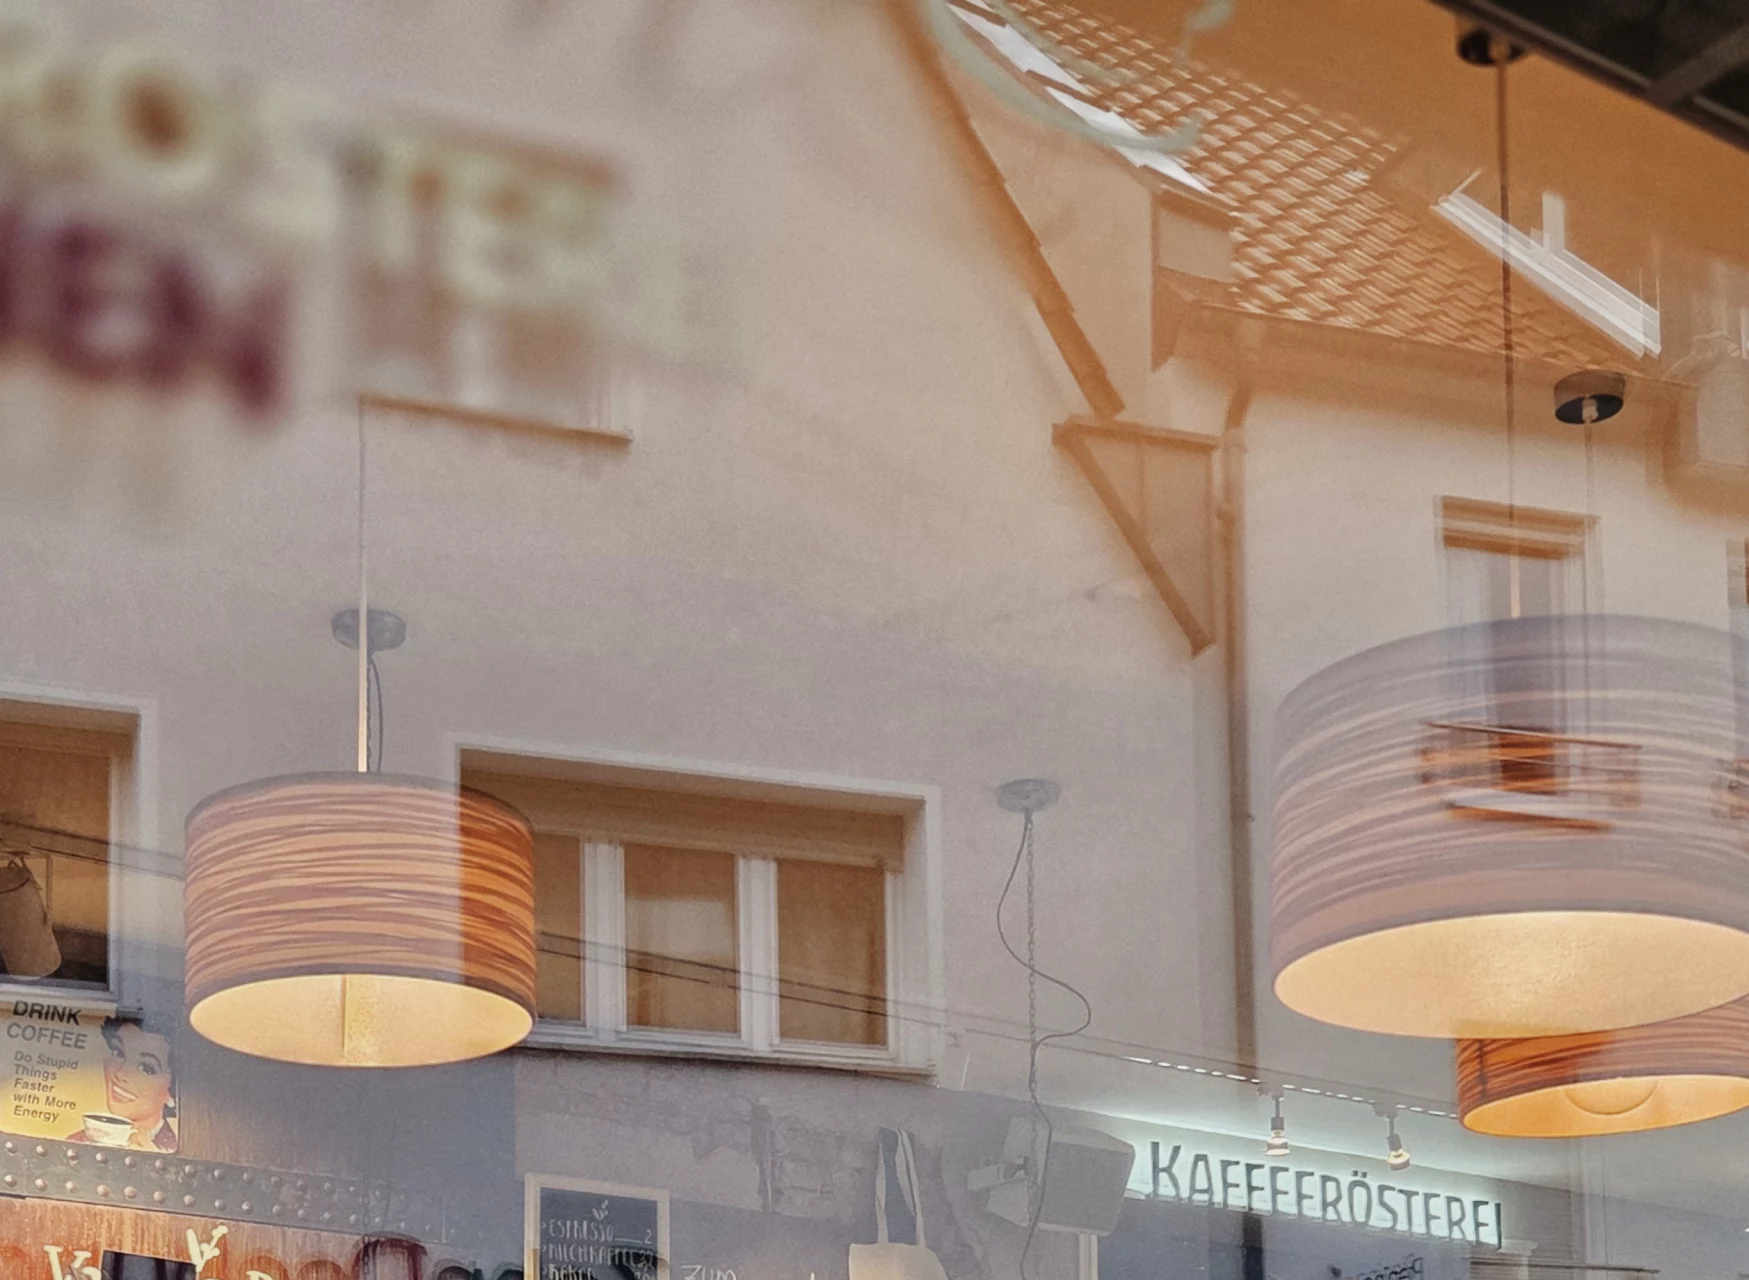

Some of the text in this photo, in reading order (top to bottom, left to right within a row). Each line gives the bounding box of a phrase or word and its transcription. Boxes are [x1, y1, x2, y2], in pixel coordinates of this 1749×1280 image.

[12, 1000, 82, 1026] DRINK
[6, 1022, 88, 1050] COFFEE
[14, 1050, 79, 1070] Do Stupid
[14, 1063, 58, 1082] Things
[13, 1077, 55, 1093] Faster
[13, 1092, 77, 1111] with More
[13, 1105, 60, 1124] Energy
[1150, 1140, 1503, 1251] KAFFEERÖSTEREI
[549, 1219, 614, 1242] ESPRESSO
